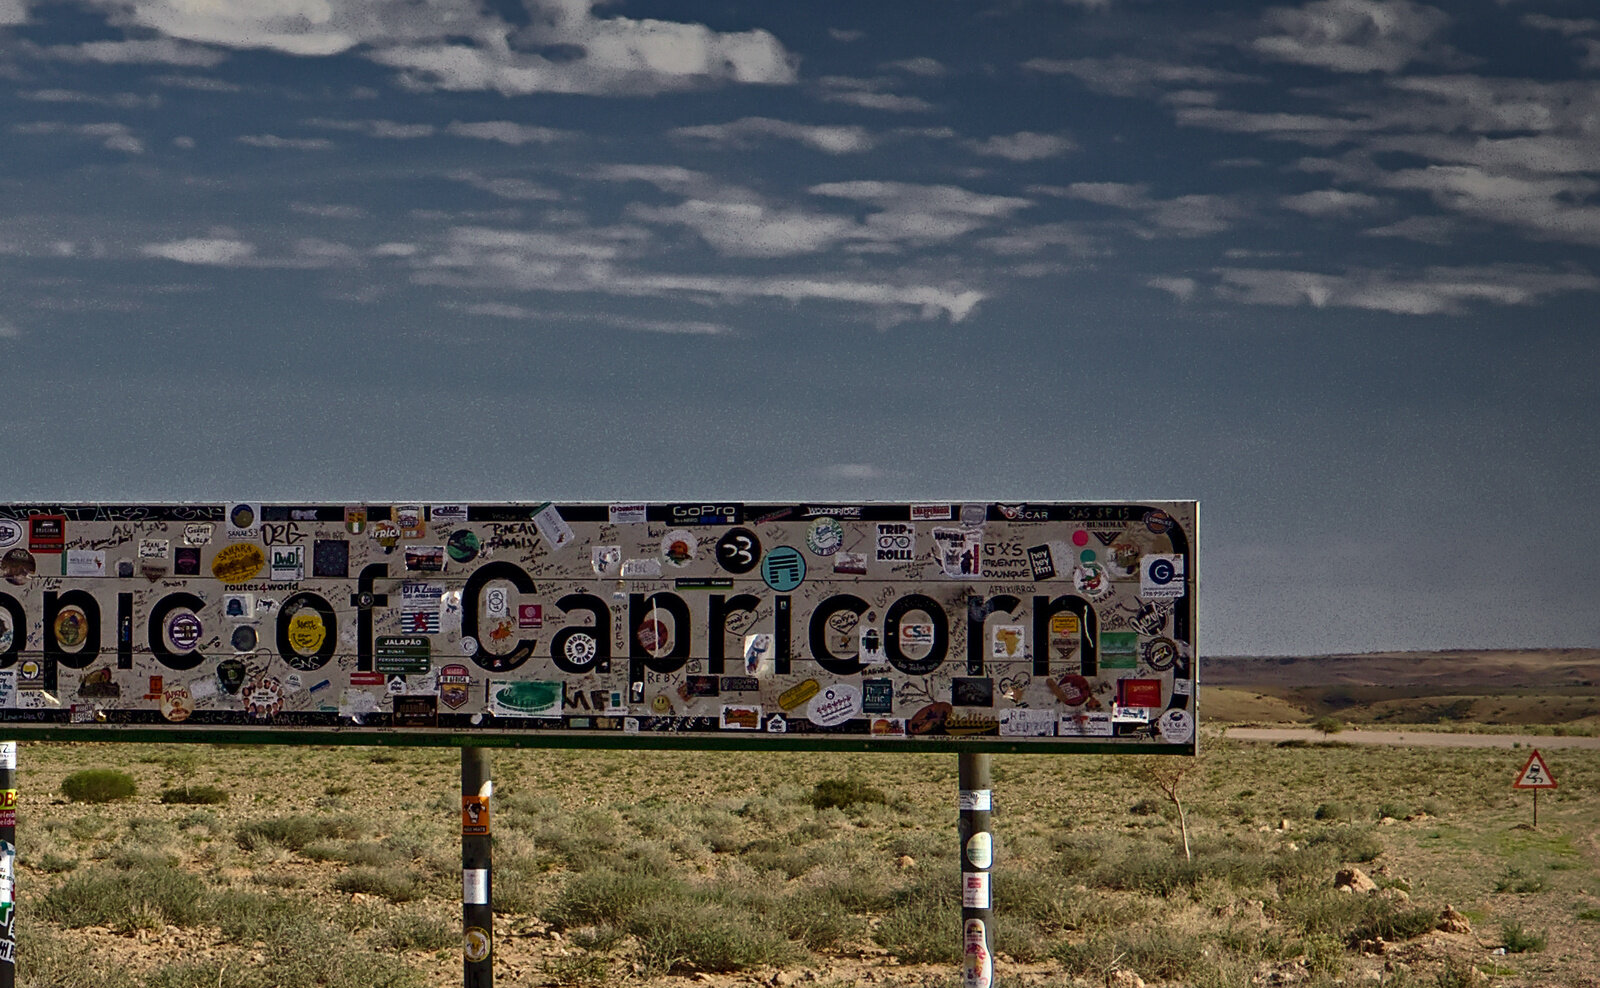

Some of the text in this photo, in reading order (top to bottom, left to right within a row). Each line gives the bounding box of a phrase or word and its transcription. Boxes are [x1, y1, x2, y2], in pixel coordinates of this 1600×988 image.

[673, 505, 736, 516] GoPro
[808, 507, 861, 515] WOODBRIDGE
[1030, 550, 1048, 559] hey
[1032, 558, 1050, 567] hey
[224, 582, 299, 593] routes4world
[276, 563, 389, 672] of
[461, 561, 1098, 703] Capricorn
[384, 638, 422, 646] JALAPÃO
